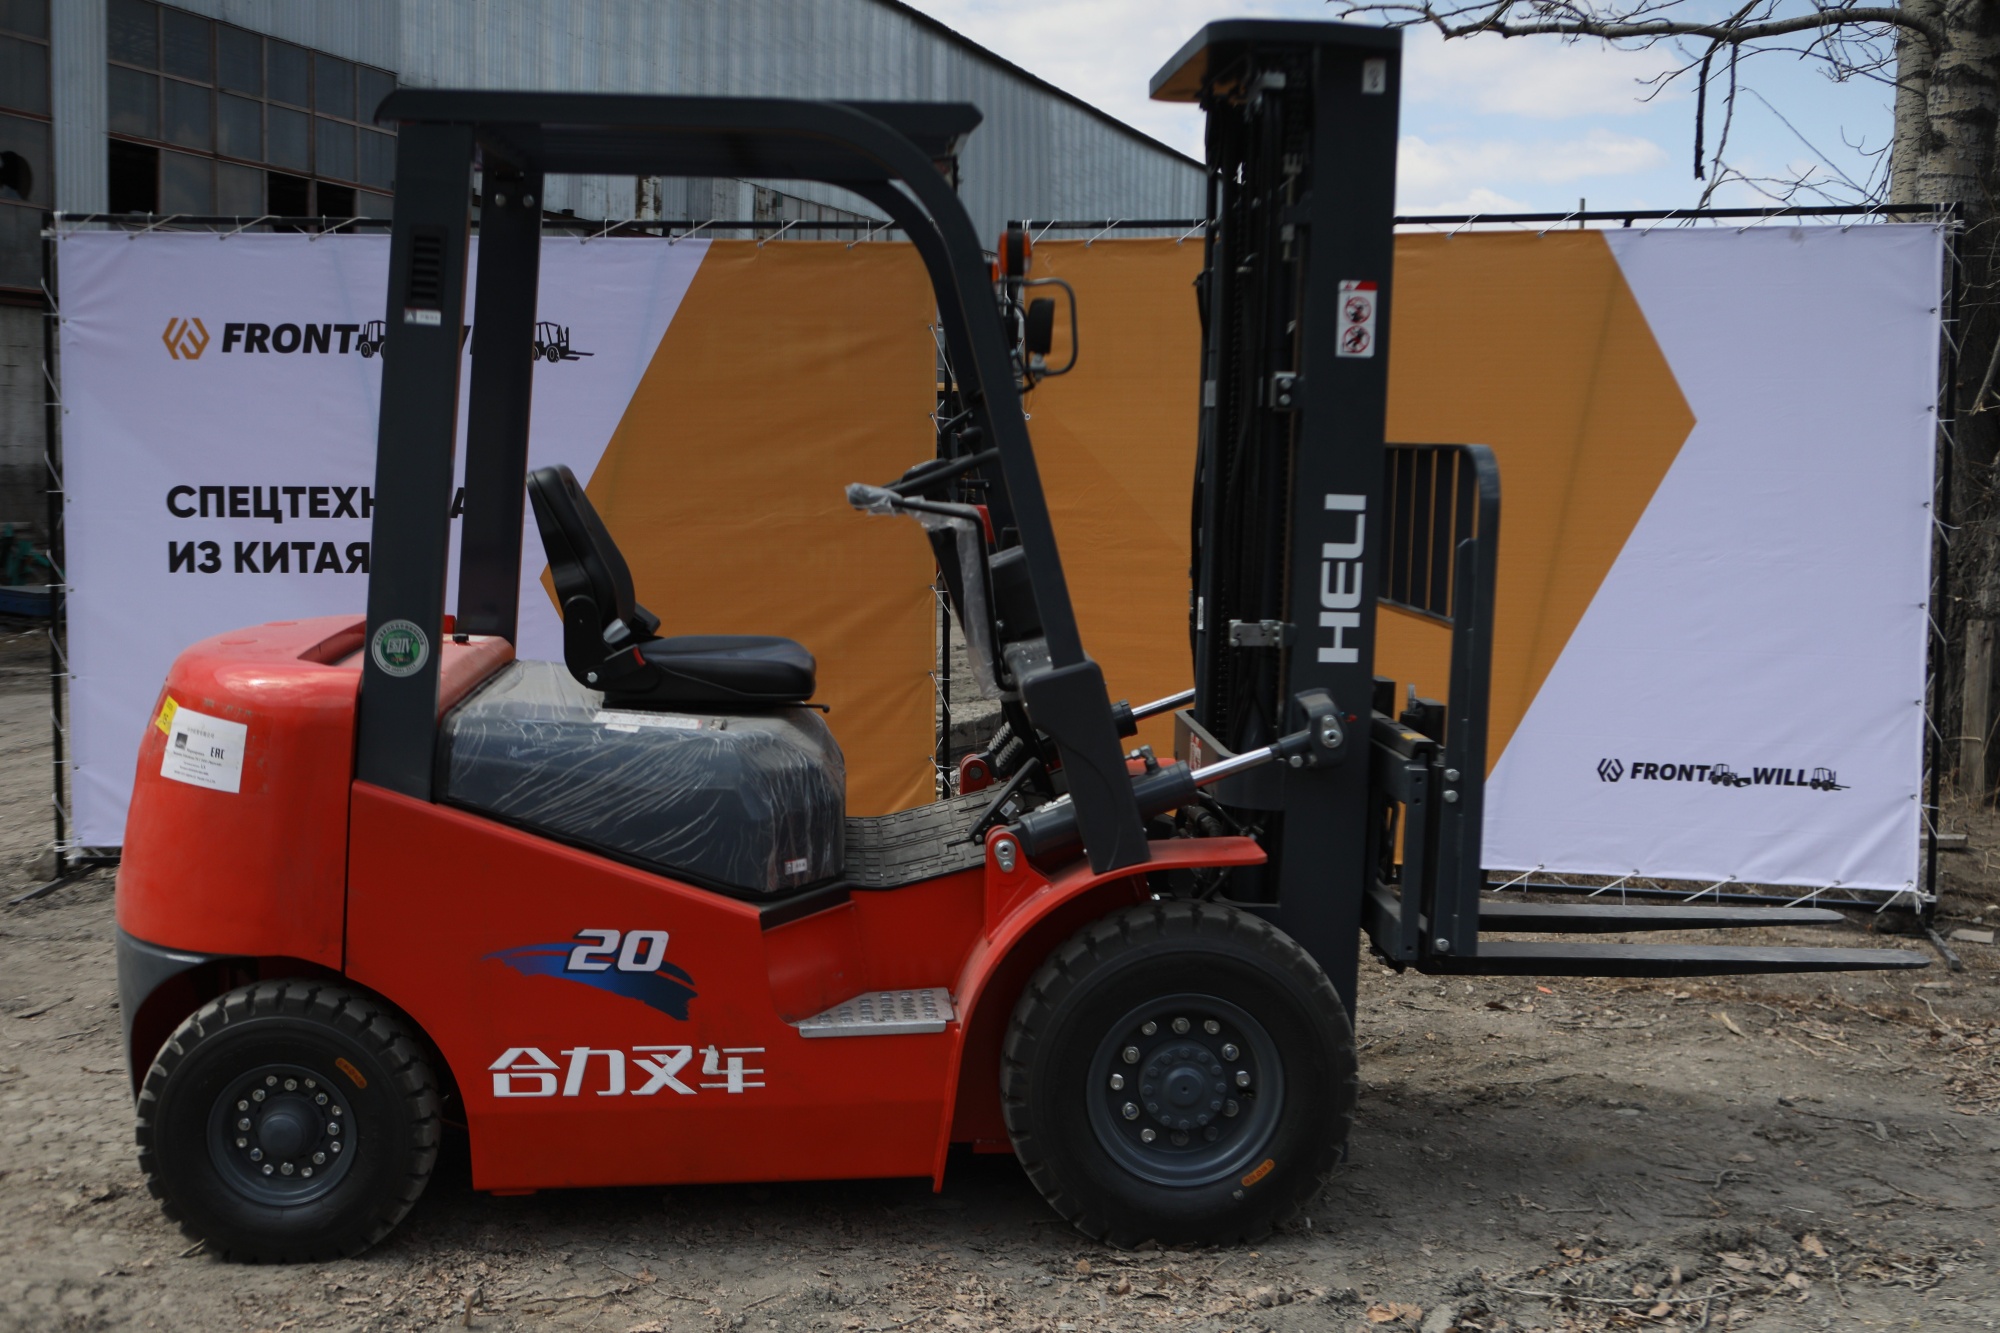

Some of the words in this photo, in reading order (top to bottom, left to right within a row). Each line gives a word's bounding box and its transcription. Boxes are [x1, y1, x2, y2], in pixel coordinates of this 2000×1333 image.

[221, 322, 360, 354] FRONT
[166, 484, 465, 524] СПЕЦТЕХН
[168, 541, 222, 574] ИЗ
[234, 541, 371, 574] КИТАЯ
[1317, 494, 1367, 663] HELI
[1630, 762, 1711, 782] FRONT
[1753, 767, 1808, 786] WILL
[565, 929, 669, 973] 20
[488, 1045, 765, 1098] 合力叉车
